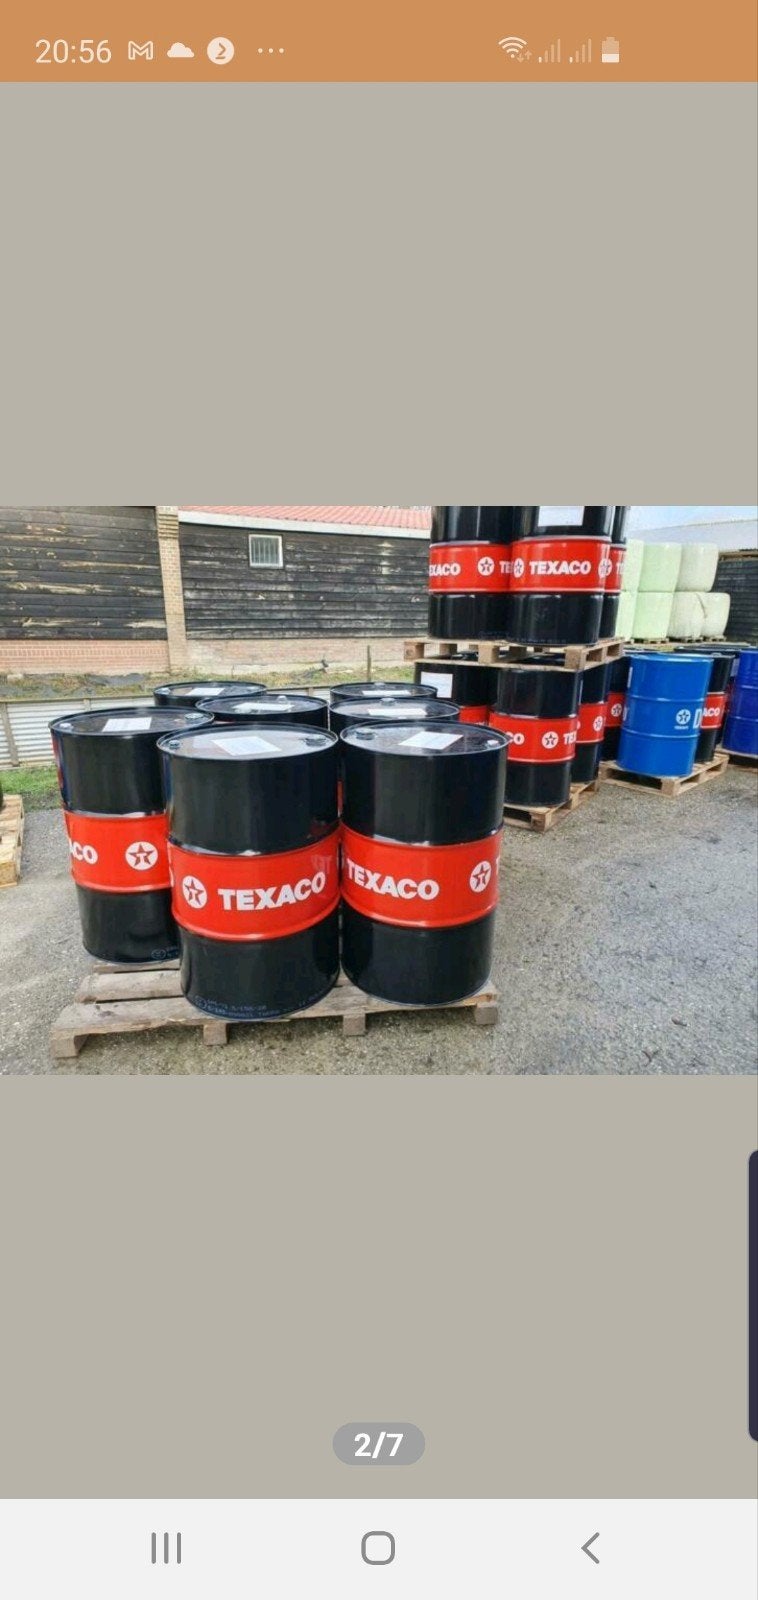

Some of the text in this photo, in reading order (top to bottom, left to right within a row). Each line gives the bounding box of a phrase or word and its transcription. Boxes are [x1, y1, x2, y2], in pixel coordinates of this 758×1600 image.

[529, 559, 592, 576] TEXACO
[218, 871, 326, 911] TEXACO
[346, 857, 440, 901] TEXACO
